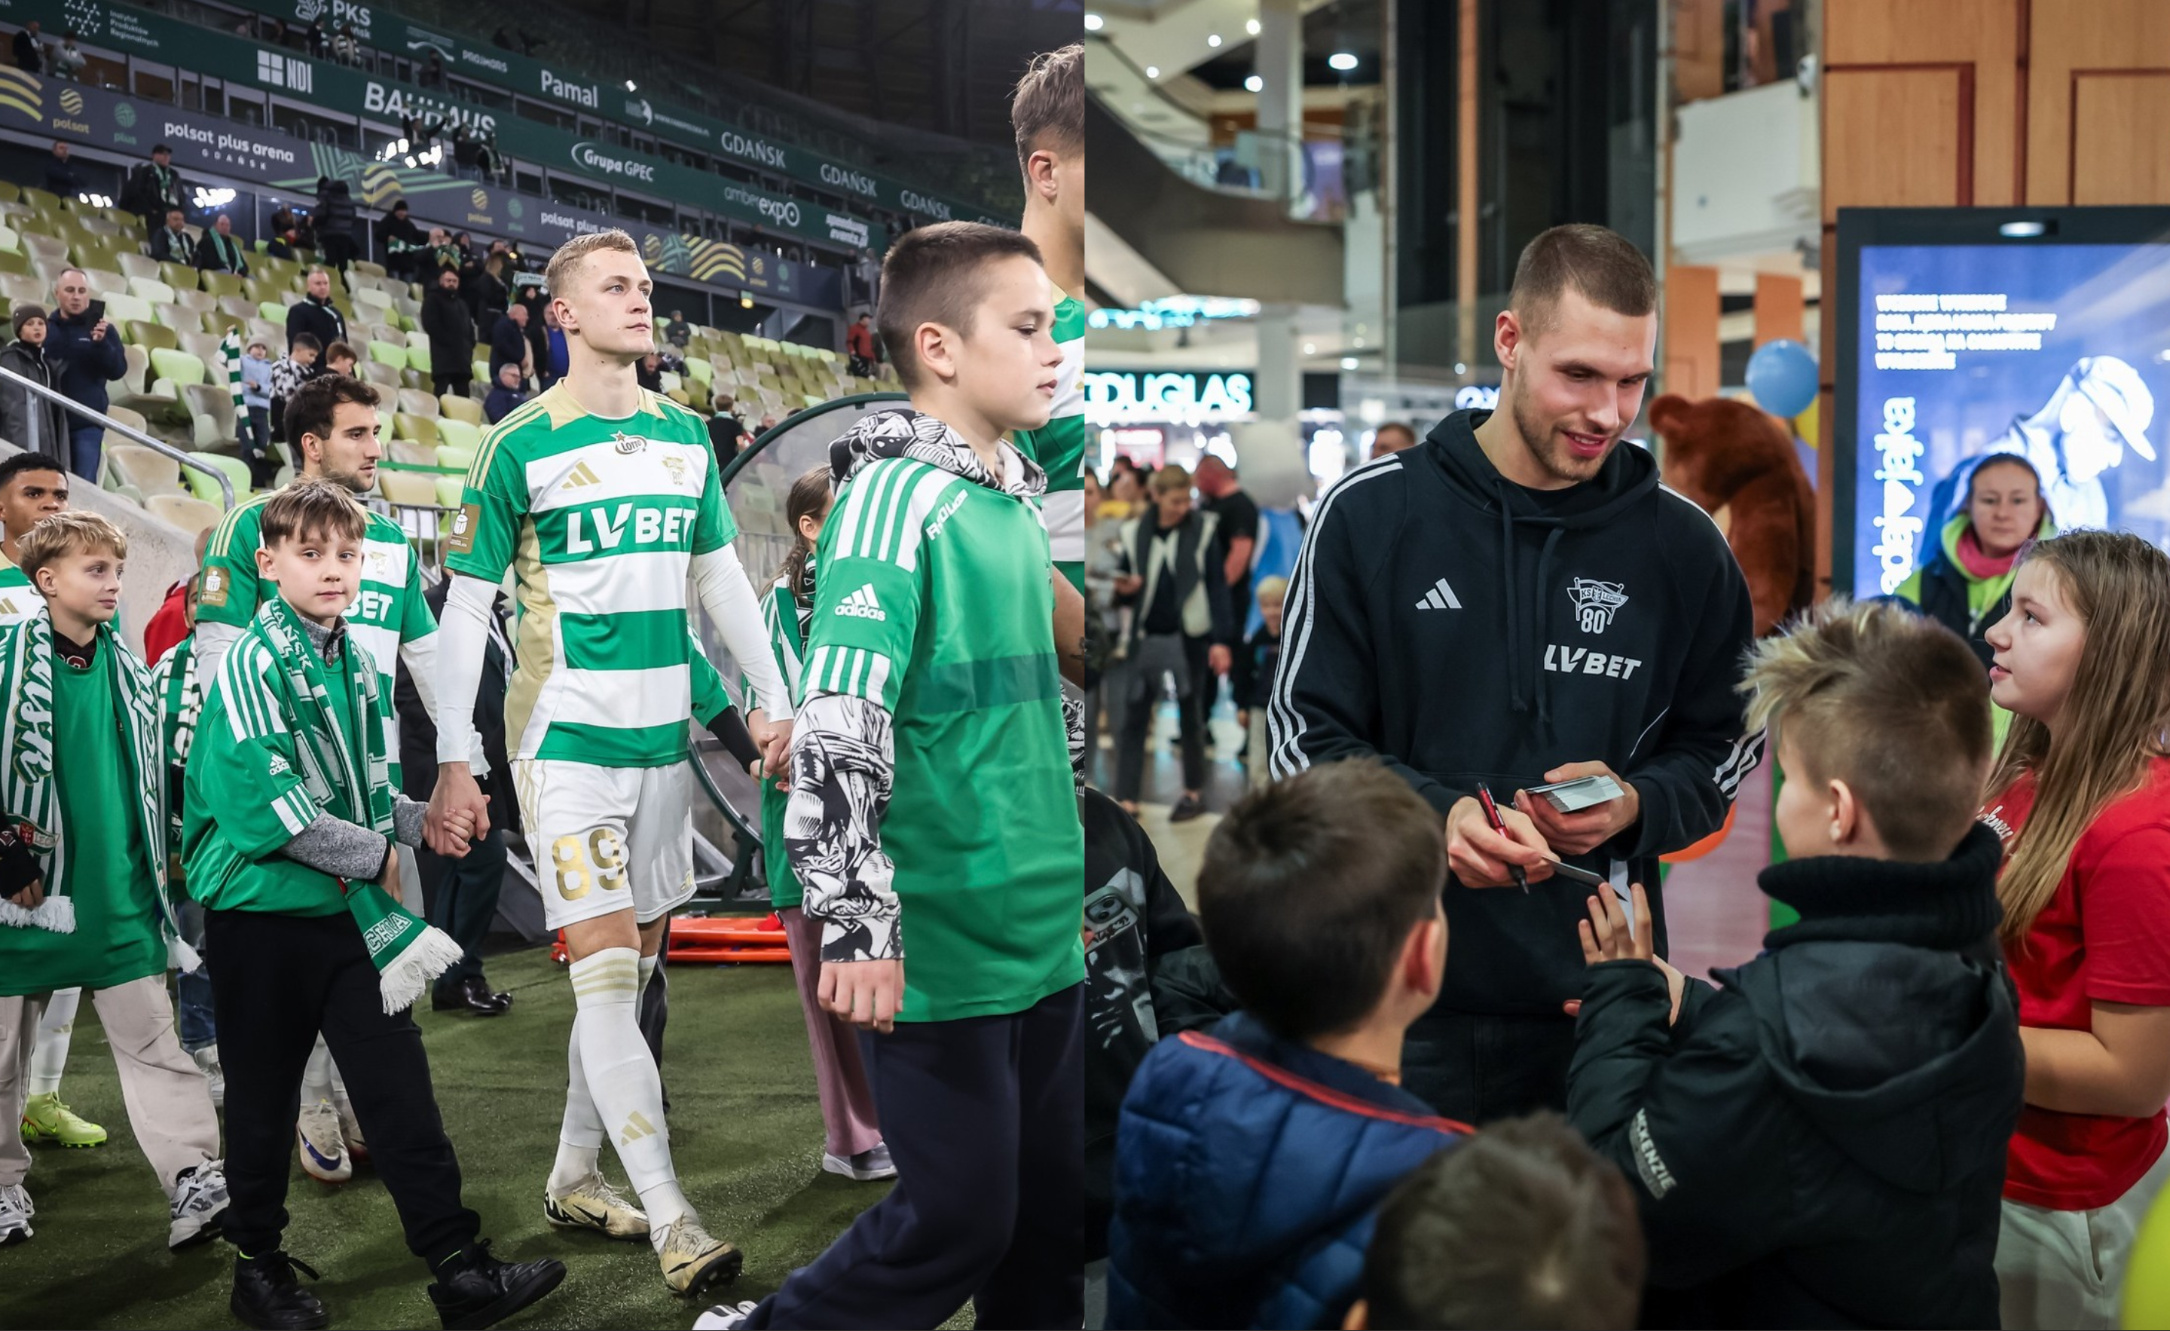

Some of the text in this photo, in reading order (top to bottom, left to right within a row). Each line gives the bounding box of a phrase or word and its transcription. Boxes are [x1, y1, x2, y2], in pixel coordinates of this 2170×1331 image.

[333, 0, 371, 26] PKS
[286, 57, 313, 94] NDI
[541, 69, 598, 108] Pamal
[53, 117, 90, 135] polsat
[114, 130, 137, 146] plus
[165, 121, 295, 164] polsat plus arena
[584, 148, 655, 182] Grupa GPEC
[721, 131, 787, 169] GDAŃSK
[820, 163, 878, 198] GDAŃSK
[541, 211, 574, 229] polsat
[901, 189, 953, 221] GDAŃSK
[340, 590, 394, 623] BET
[834, 602, 886, 622] adidas
[1581, 608, 1606, 634] 80
[552, 828, 625, 901] 89
